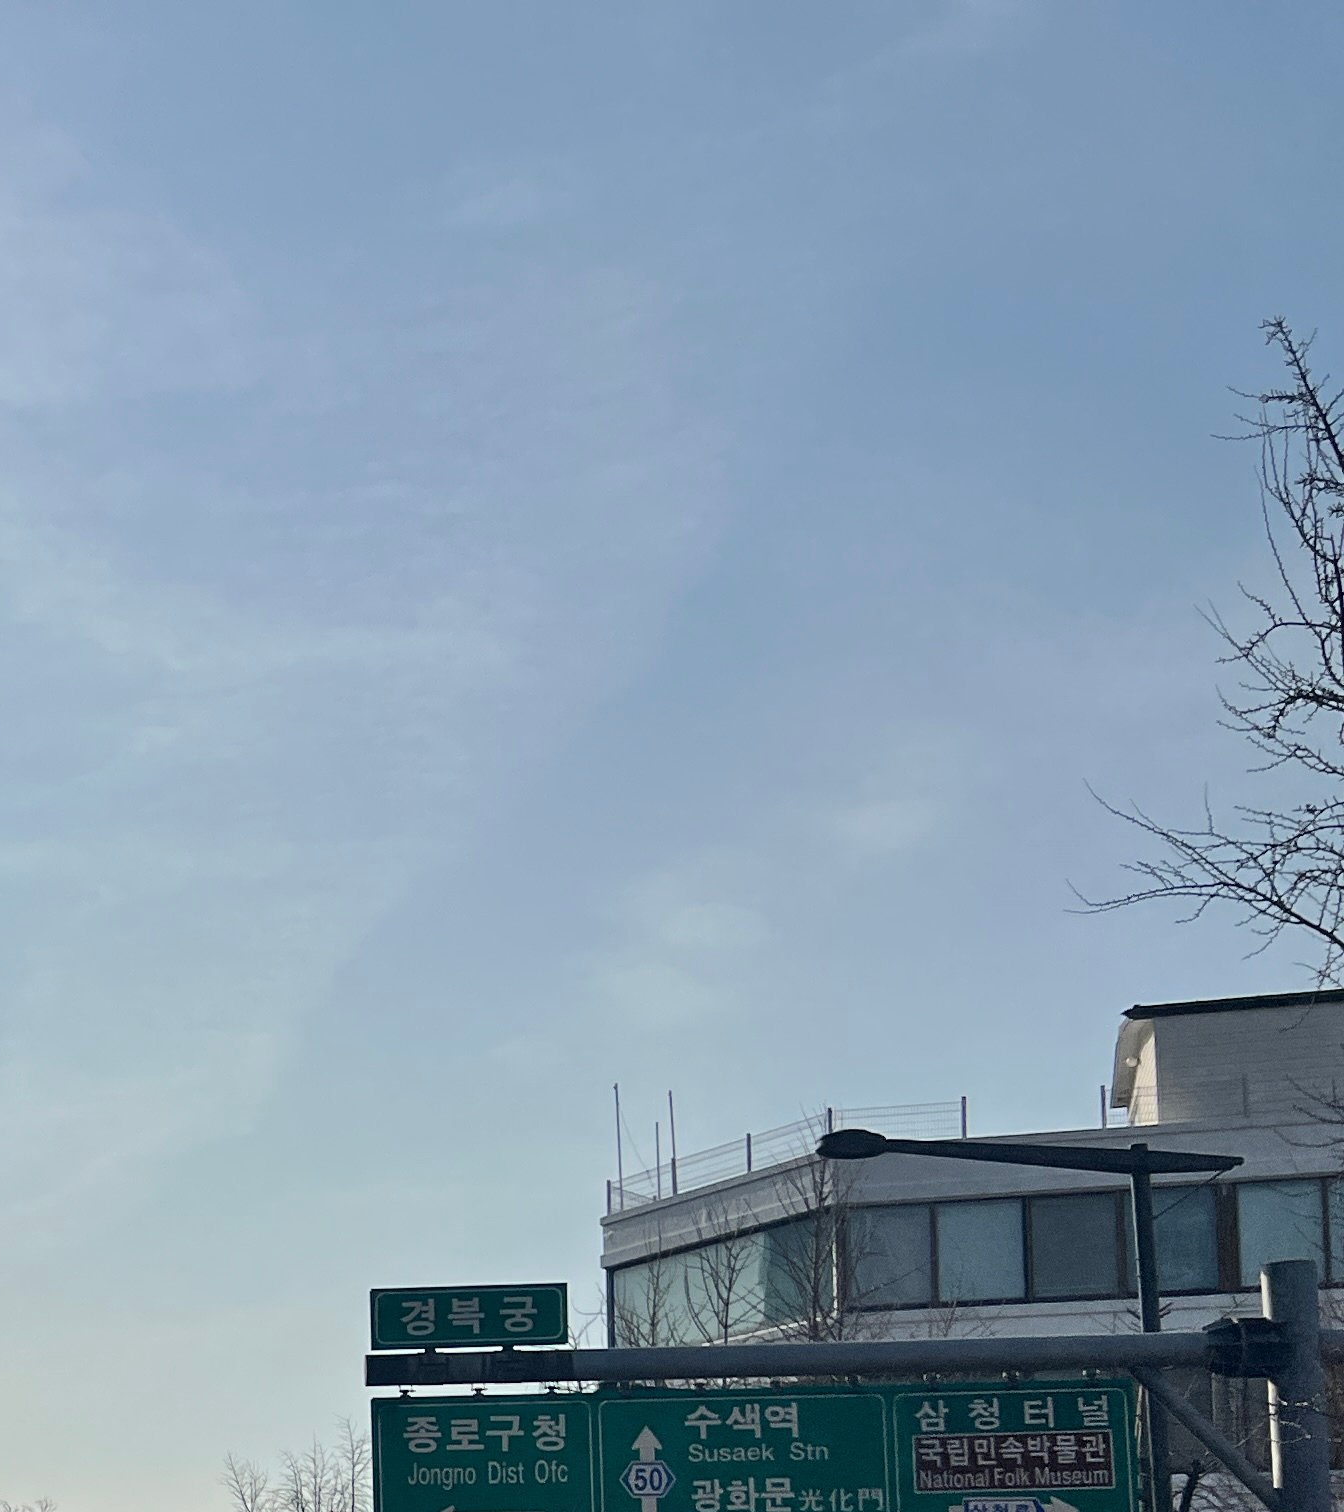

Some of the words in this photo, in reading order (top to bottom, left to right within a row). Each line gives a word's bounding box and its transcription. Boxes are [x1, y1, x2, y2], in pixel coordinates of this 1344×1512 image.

[399, 1295, 538, 1337] 경복궁
[684, 1402, 800, 1439] 수색역
[915, 1394, 1110, 1432] 삼청터널
[402, 1413, 566, 1453] 종로구청
[918, 1433, 1107, 1467] 국립민속박물관
[688, 1443, 775, 1463] Susaek
[789, 1441, 829, 1461] Stn
[407, 1461, 476, 1490] Jongno
[487, 1460, 525, 1484] Dist
[534, 1459, 569, 1484] Ofc
[633, 1467, 664, 1492] 50
[919, 1470, 991, 1489] National
[993, 1467, 1030, 1487] Folk
[1035, 1466, 1109, 1486] Museum
